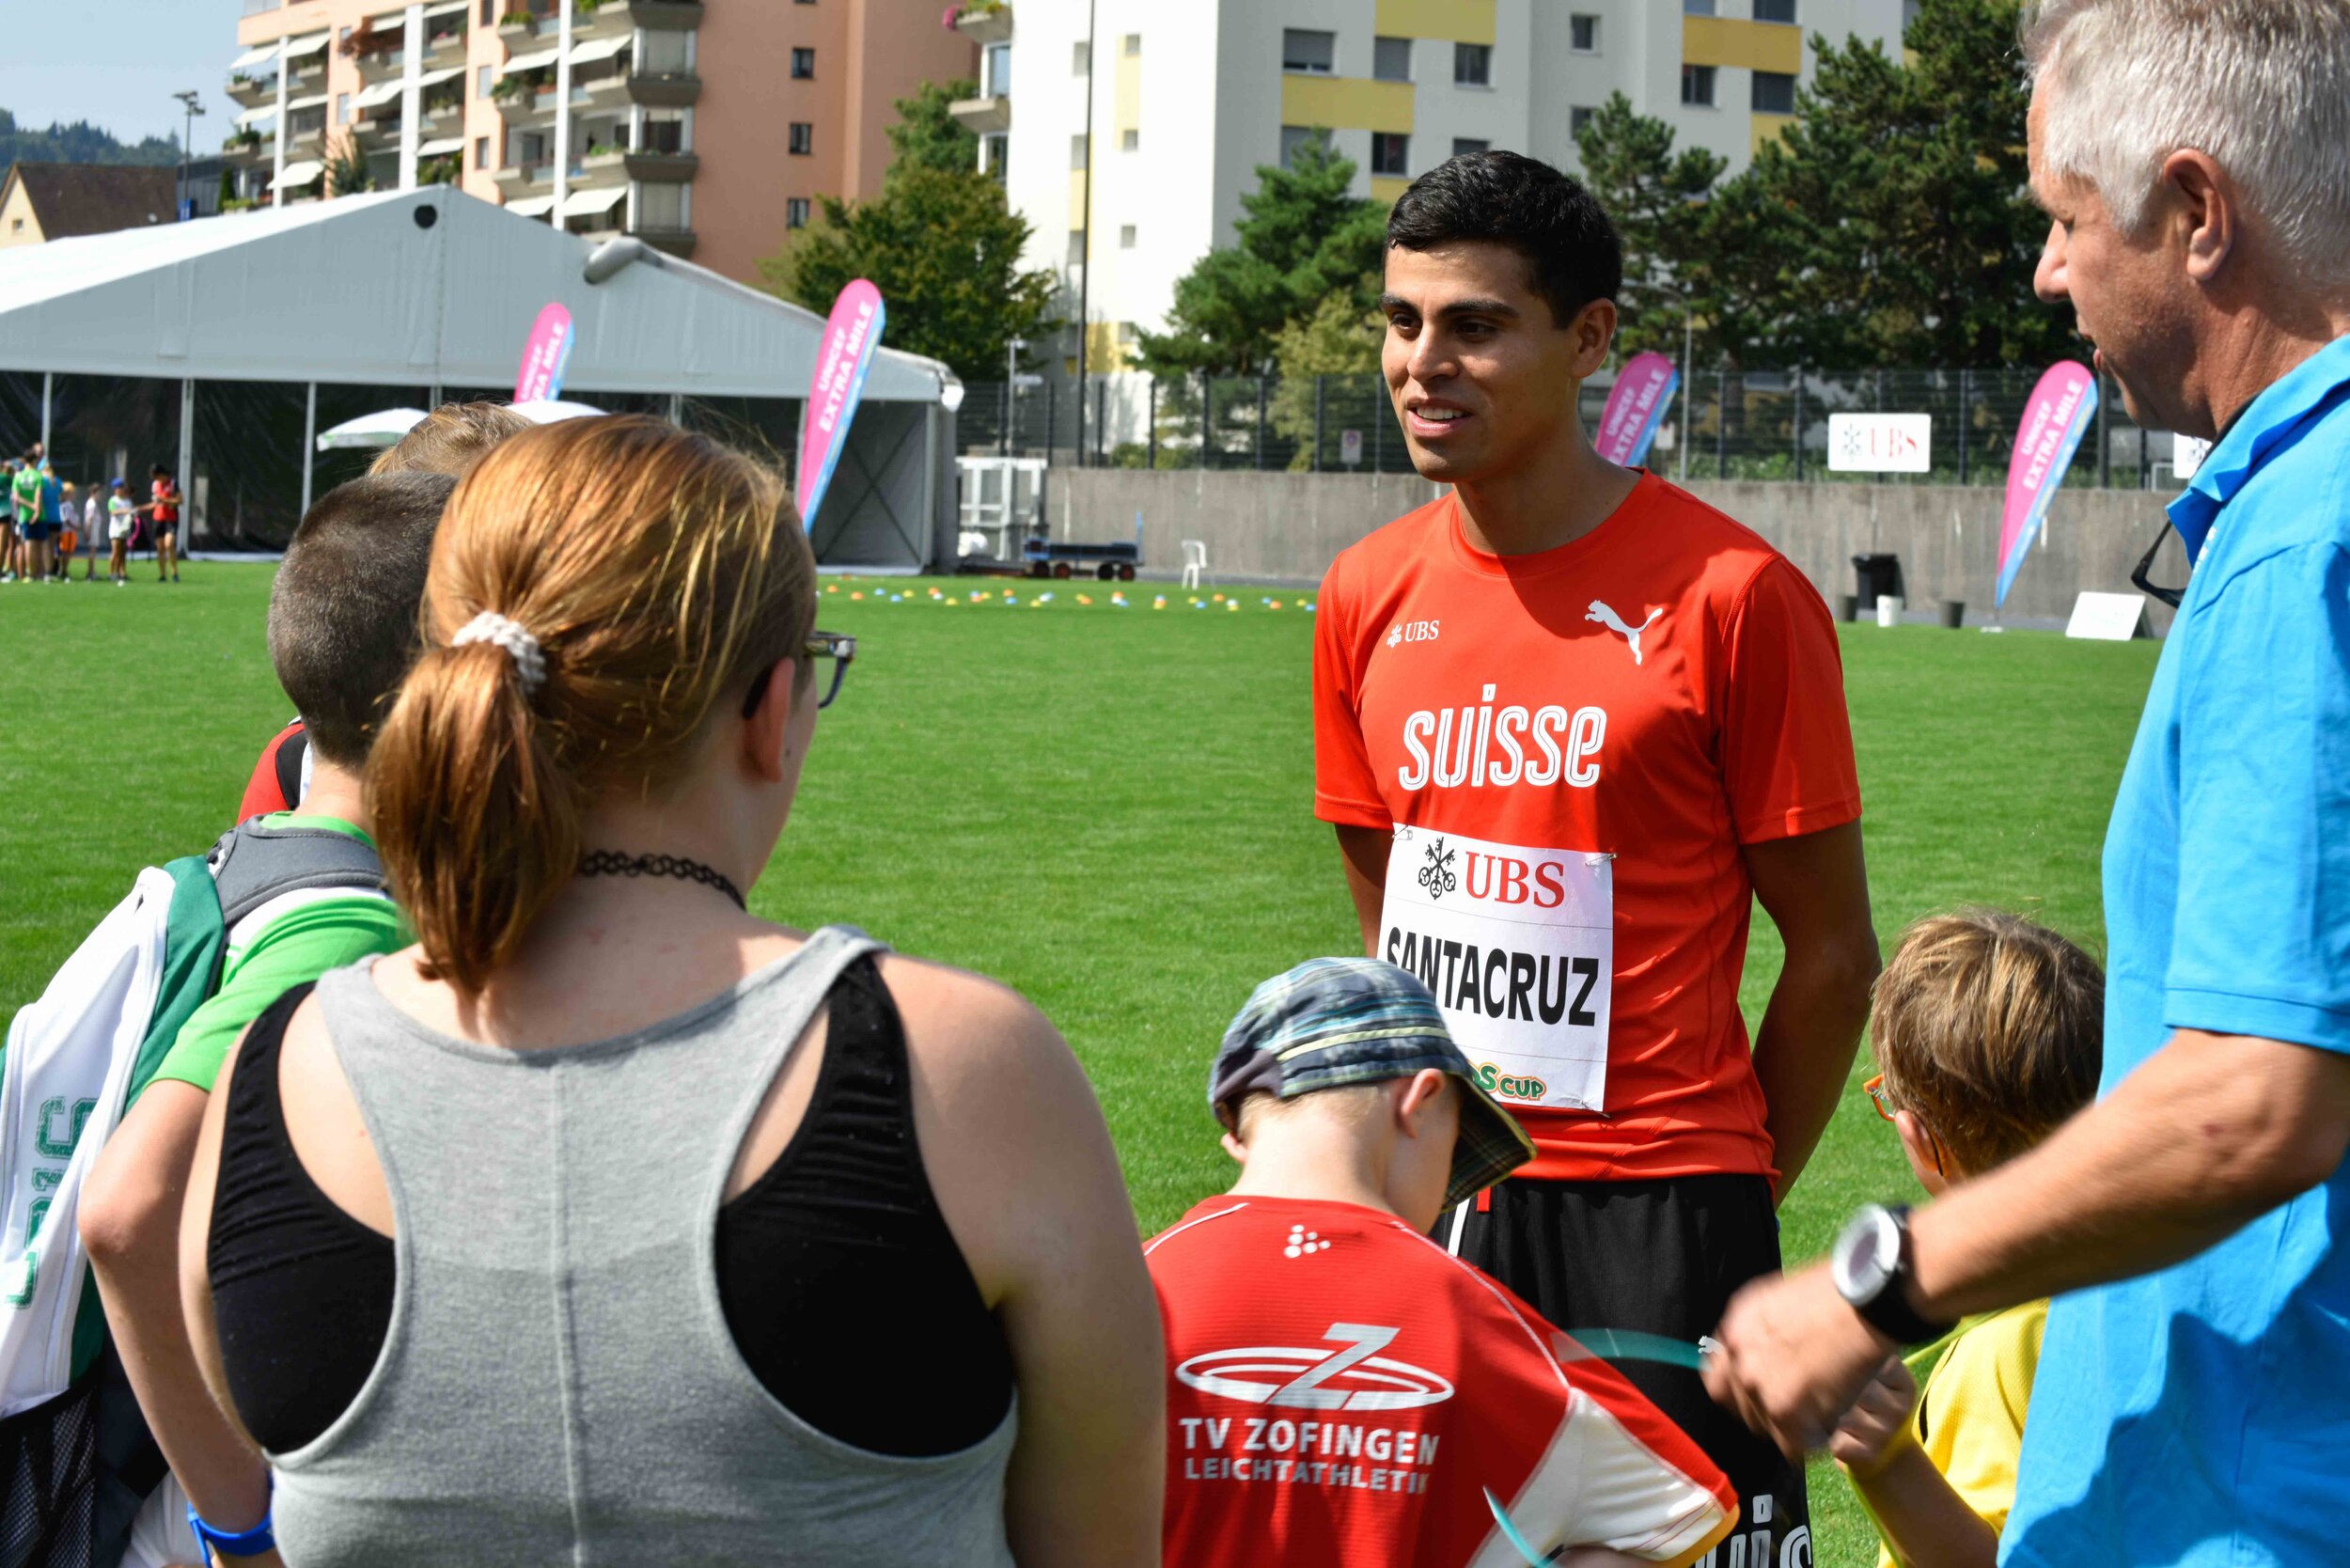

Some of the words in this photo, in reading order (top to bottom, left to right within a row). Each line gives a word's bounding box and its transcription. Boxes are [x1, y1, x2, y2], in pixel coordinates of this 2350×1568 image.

[818, 327, 846, 392] UNICEF
[819, 360, 853, 432] EXTRA
[846, 302, 873, 356] MILE
[1637, 368, 1666, 411] MILE
[2021, 400, 2053, 456] UNICEF
[2023, 428, 2060, 491] EXTRA
[2052, 379, 2083, 427] MILE
[1404, 620, 1439, 642] UBS
[1398, 683, 1606, 791] suisse
[1465, 851, 1565, 908] UBS
[1499, 1076, 1544, 1098] CUP
[1179, 1418, 1231, 1450] TV
[1243, 1418, 1440, 1465] ZOFINGEN
